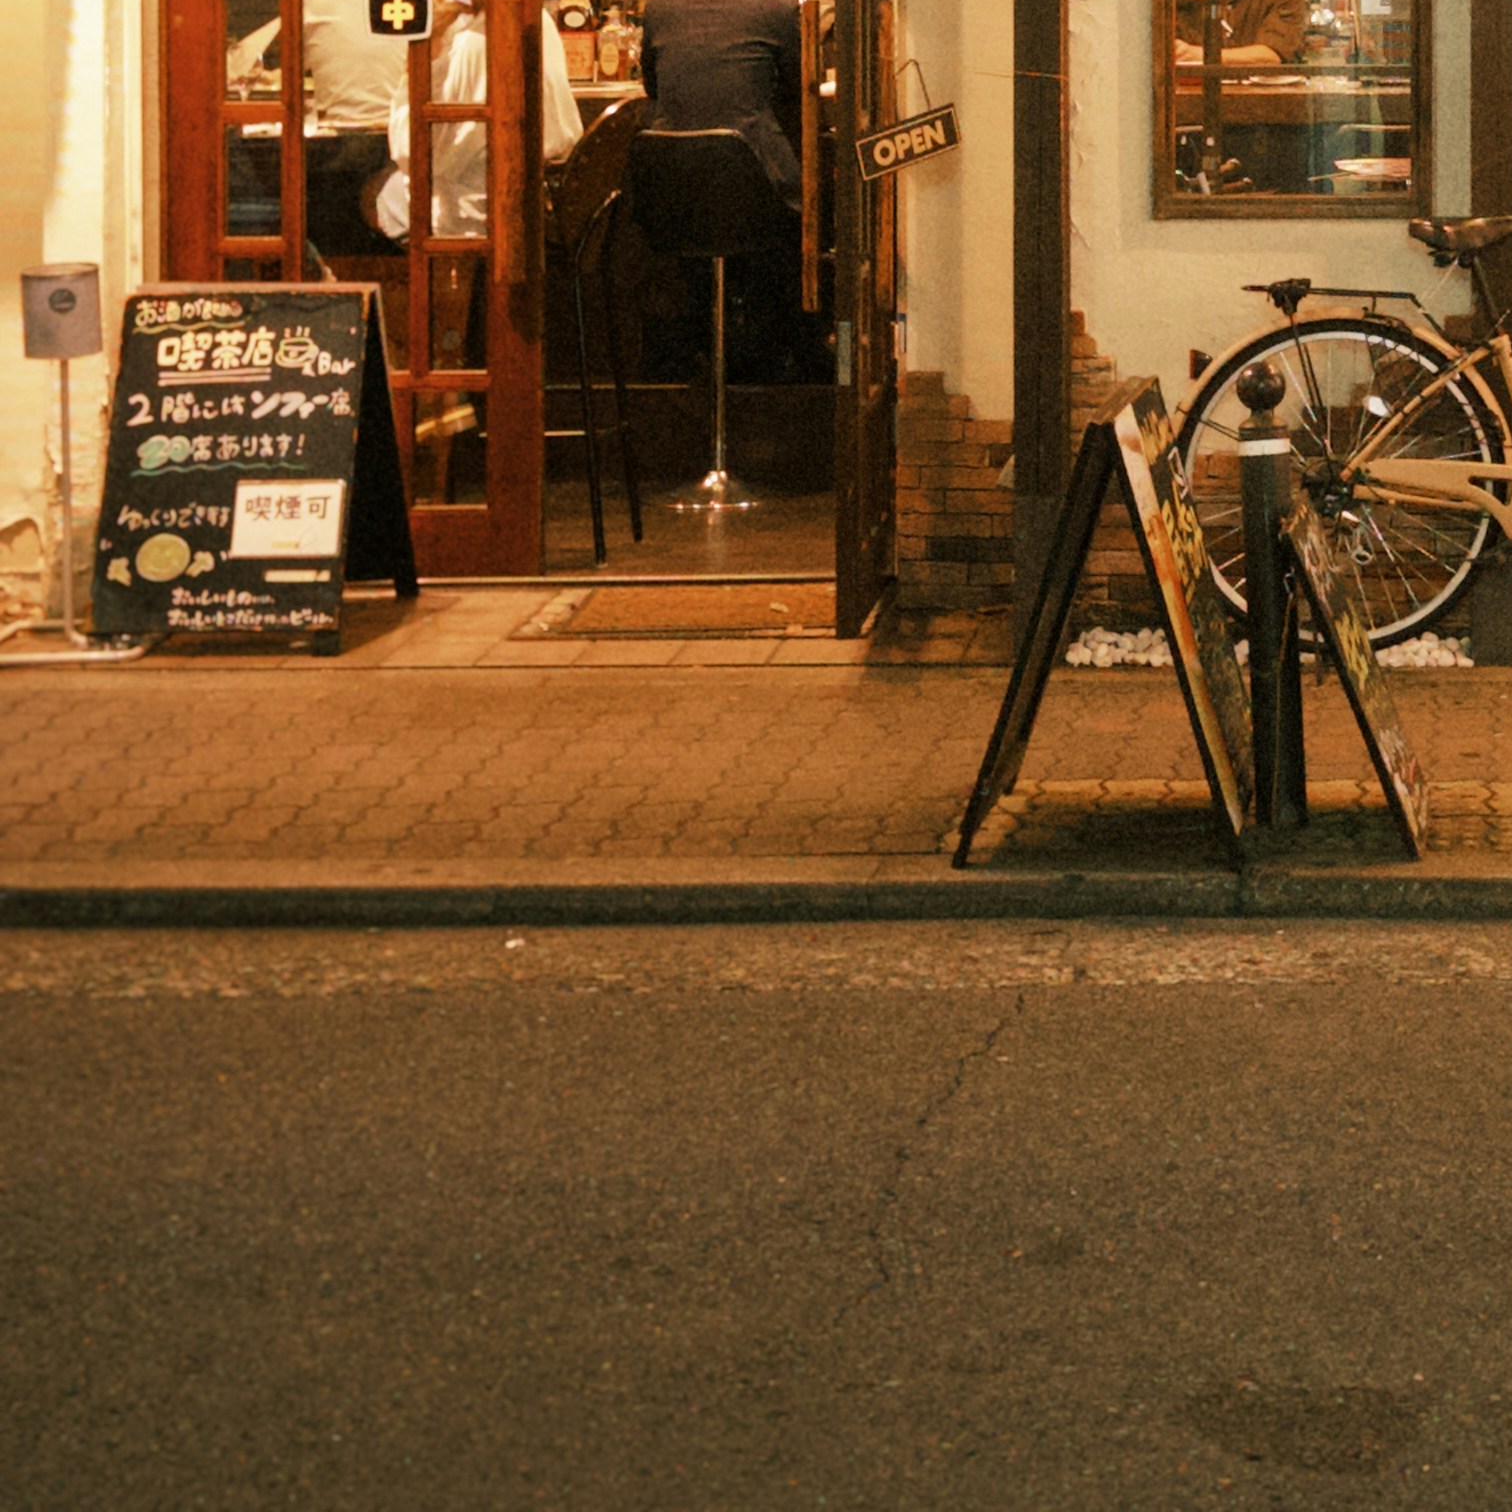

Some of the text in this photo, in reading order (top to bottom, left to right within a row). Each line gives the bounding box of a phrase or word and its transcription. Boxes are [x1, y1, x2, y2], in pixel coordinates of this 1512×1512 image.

[872, 118, 947, 167] OPEN
[157, 325, 277, 372] 喫茶店
[243, 494, 332, 522] 喫煙可
